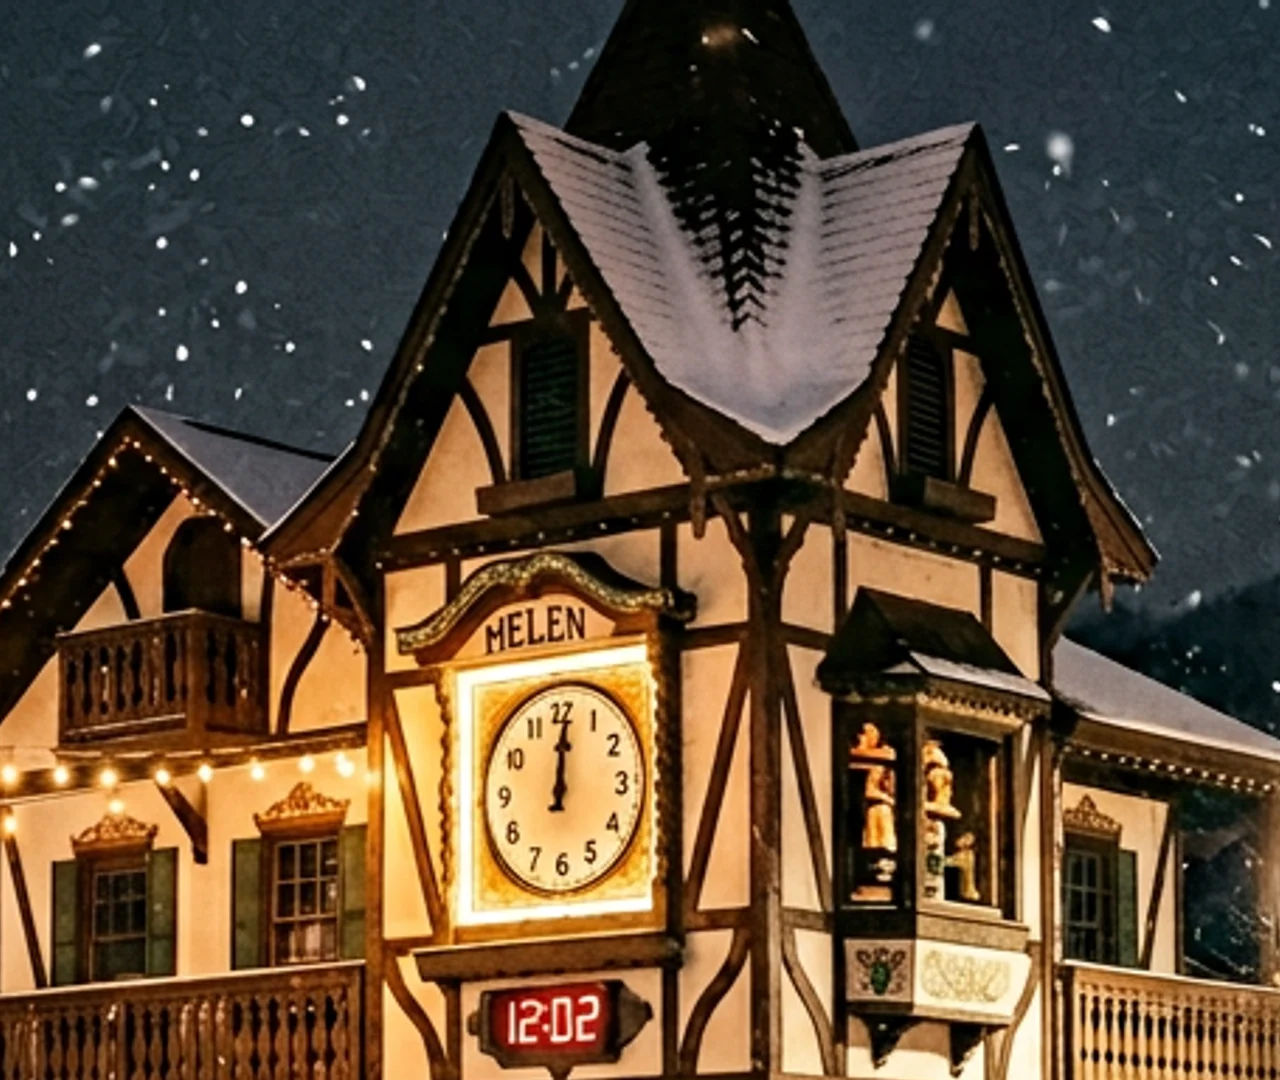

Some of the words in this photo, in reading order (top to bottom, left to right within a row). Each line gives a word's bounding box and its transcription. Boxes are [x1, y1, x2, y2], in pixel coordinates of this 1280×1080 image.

[485, 605, 585, 656] MELEN
[527, 716, 543, 738] 11
[590, 708, 597, 732] 1
[606, 732, 620, 757] 2
[507, 748, 524, 771] 10
[614, 770, 628, 796] 3
[498, 785, 512, 809] 9
[505, 820, 520, 845] 8
[606, 811, 619, 833] 4
[529, 846, 542, 872] 7
[555, 852, 569, 876] 6
[584, 839, 597, 865] 5
[507, 995, 600, 1045] 12:02
